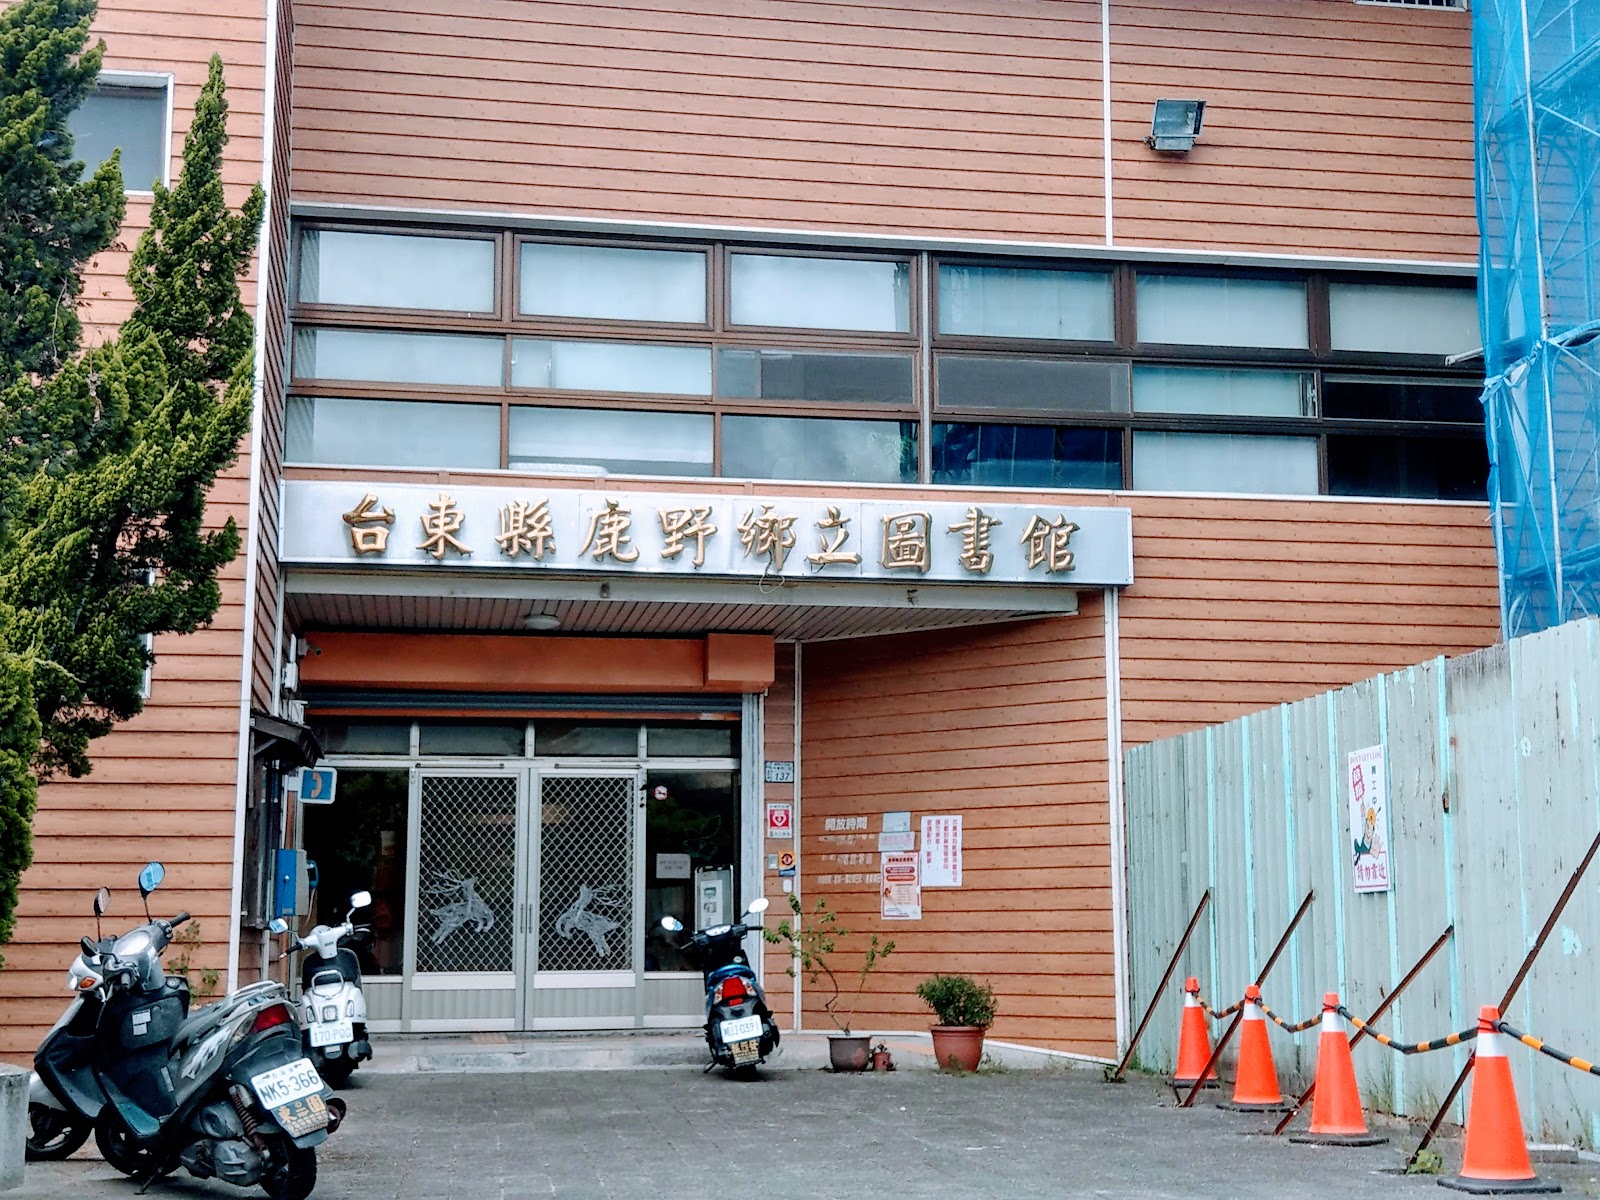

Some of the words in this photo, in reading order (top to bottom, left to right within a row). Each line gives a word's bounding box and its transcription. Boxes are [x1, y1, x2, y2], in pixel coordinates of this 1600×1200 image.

[342, 493, 1077, 575] 台東縣鹿野鄉立圖書館
[775, 772, 790, 781] 137
[825, 816, 868, 831] 開放時間
[1357, 862, 1386, 882] 請勿靠近
